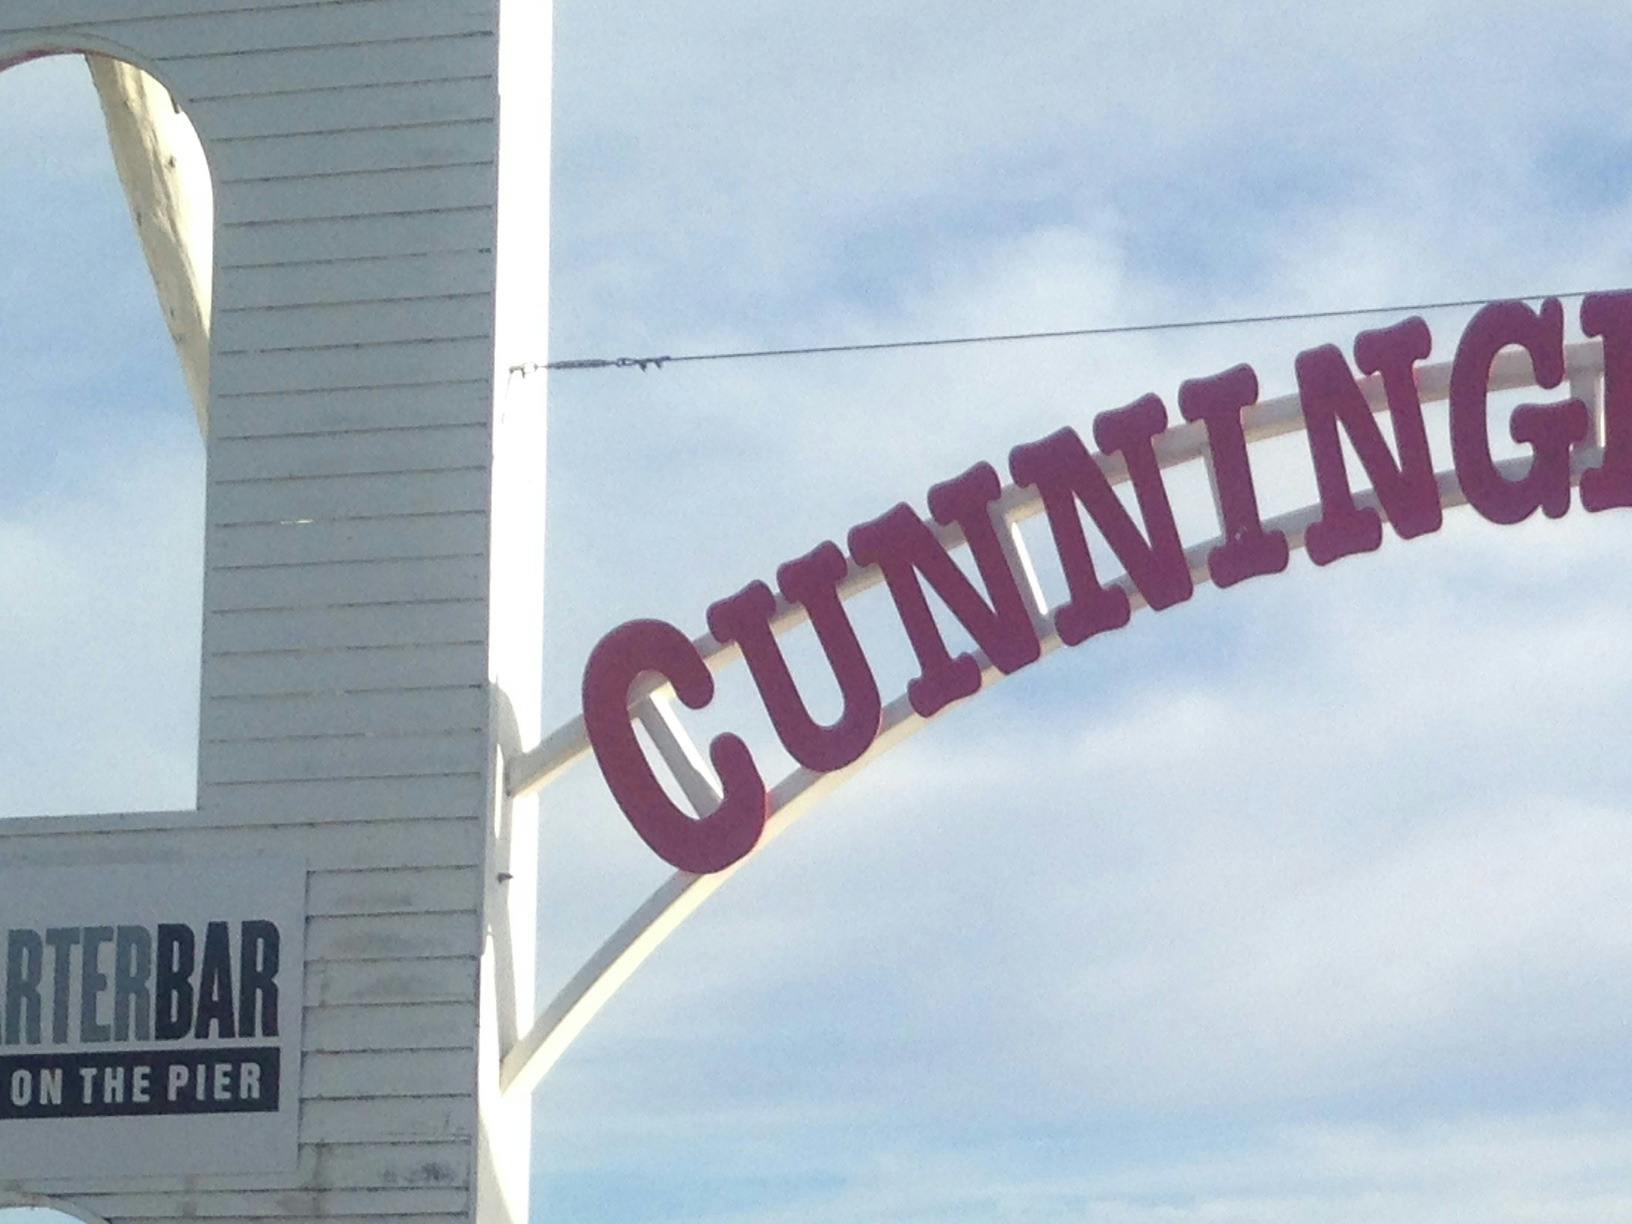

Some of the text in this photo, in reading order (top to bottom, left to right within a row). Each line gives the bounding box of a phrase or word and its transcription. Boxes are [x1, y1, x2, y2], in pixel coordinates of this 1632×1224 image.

[11, 1062, 261, 1106] ON THE PIER
